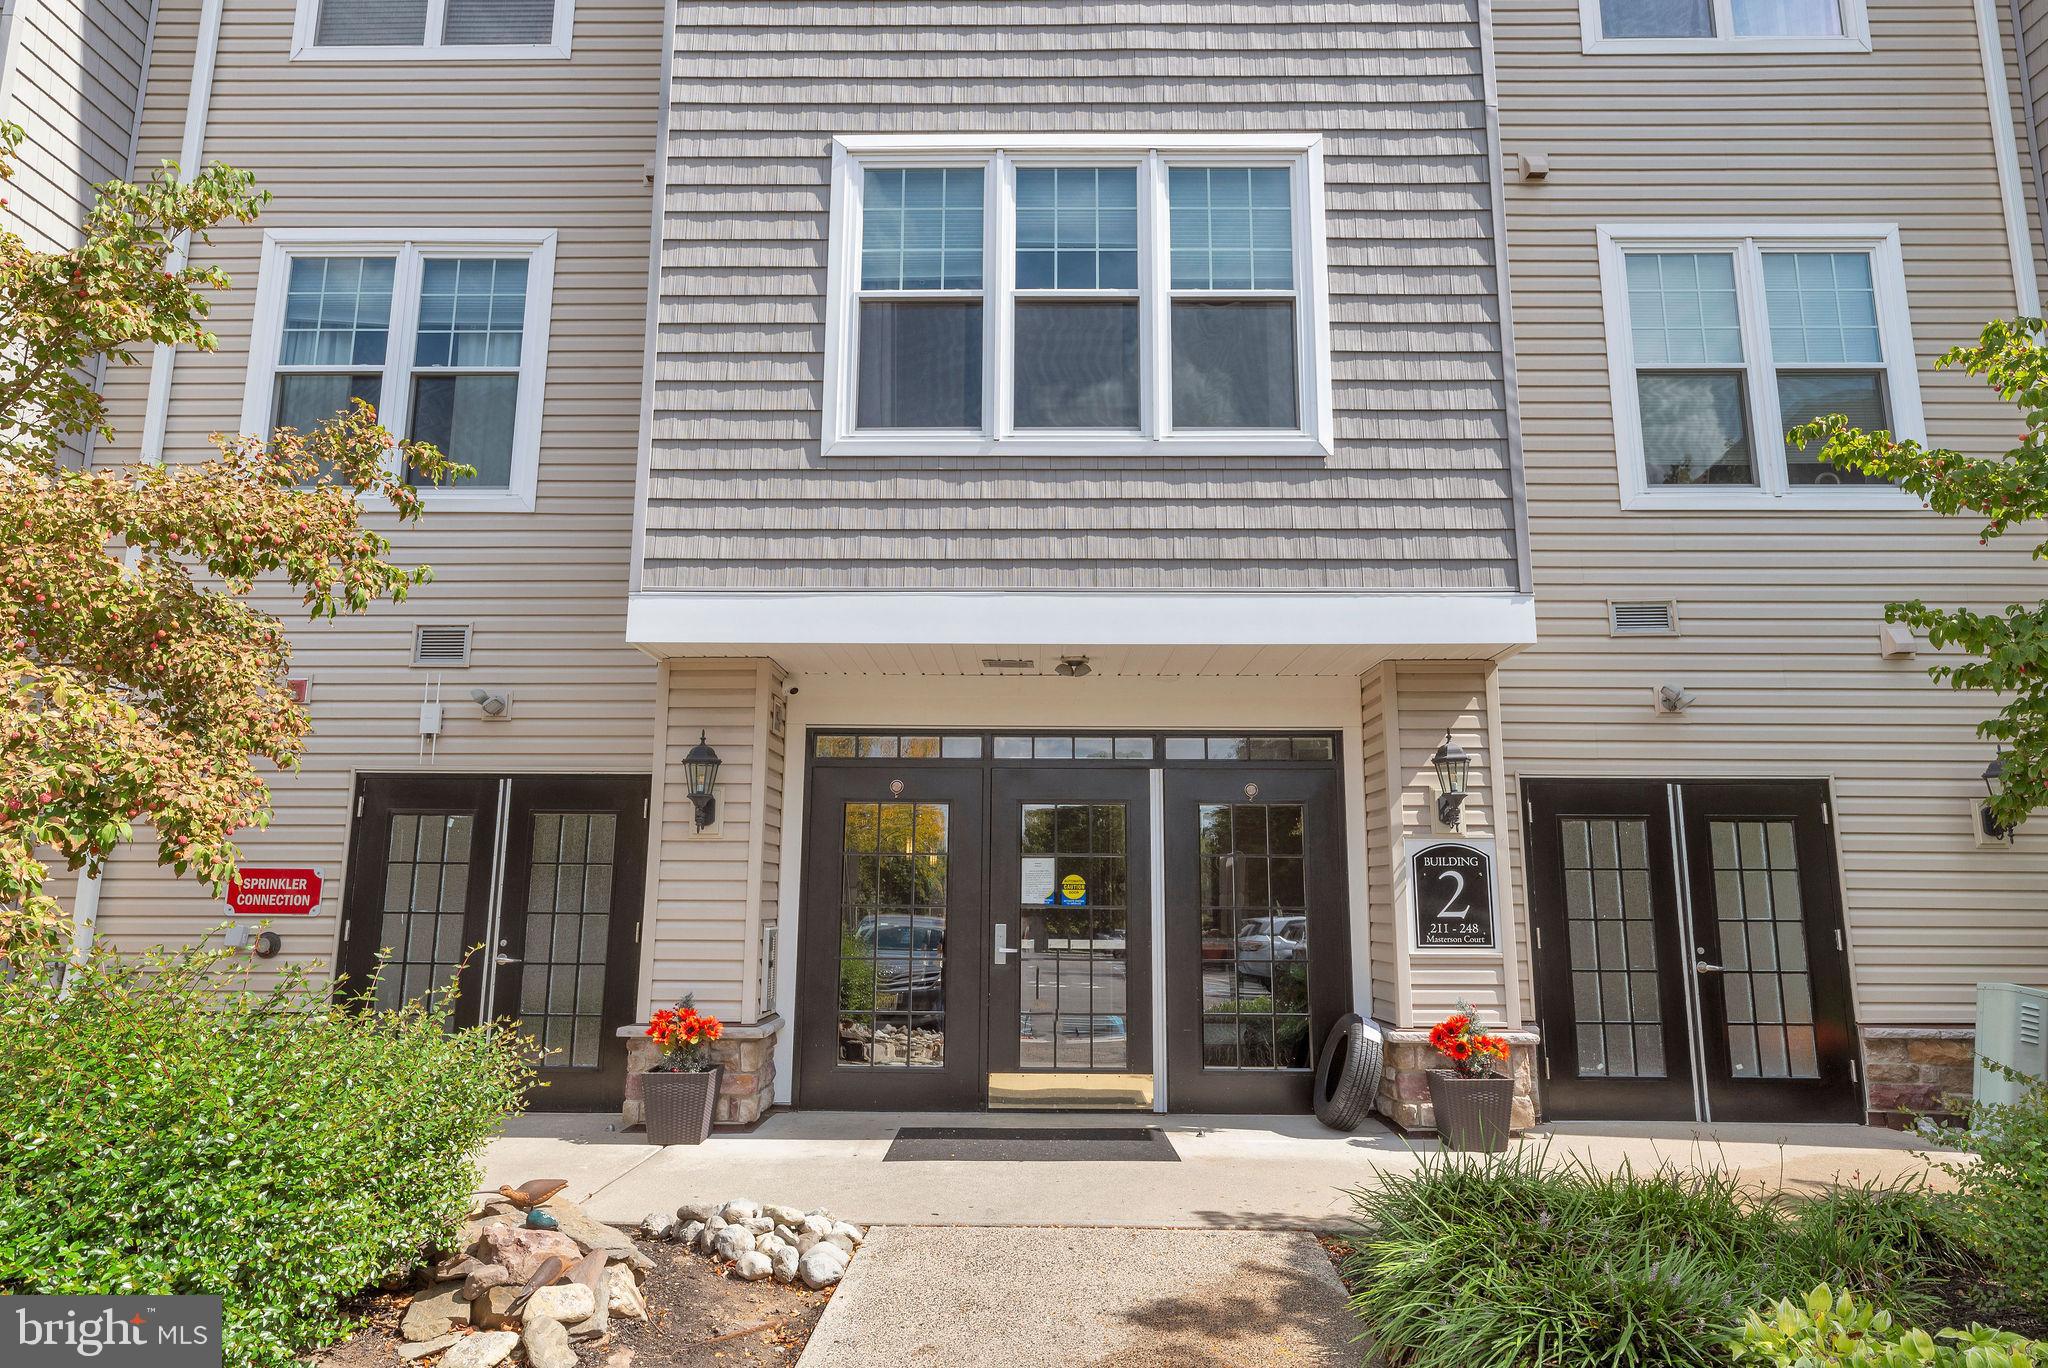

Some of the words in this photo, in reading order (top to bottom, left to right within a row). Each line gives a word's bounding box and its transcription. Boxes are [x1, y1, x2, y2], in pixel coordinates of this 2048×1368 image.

[1424, 857, 1478, 867] BUILDING
[243, 878, 307, 890] SPRINKLER
[236, 894, 311, 906] CONNECTION
[1437, 870, 1470, 919] 2
[1430, 923, 1448, 934] 211
[1459, 923, 1479, 934] 248
[1426, 935, 1462, 943] Masterson
[1463, 935, 1485, 943] Court
